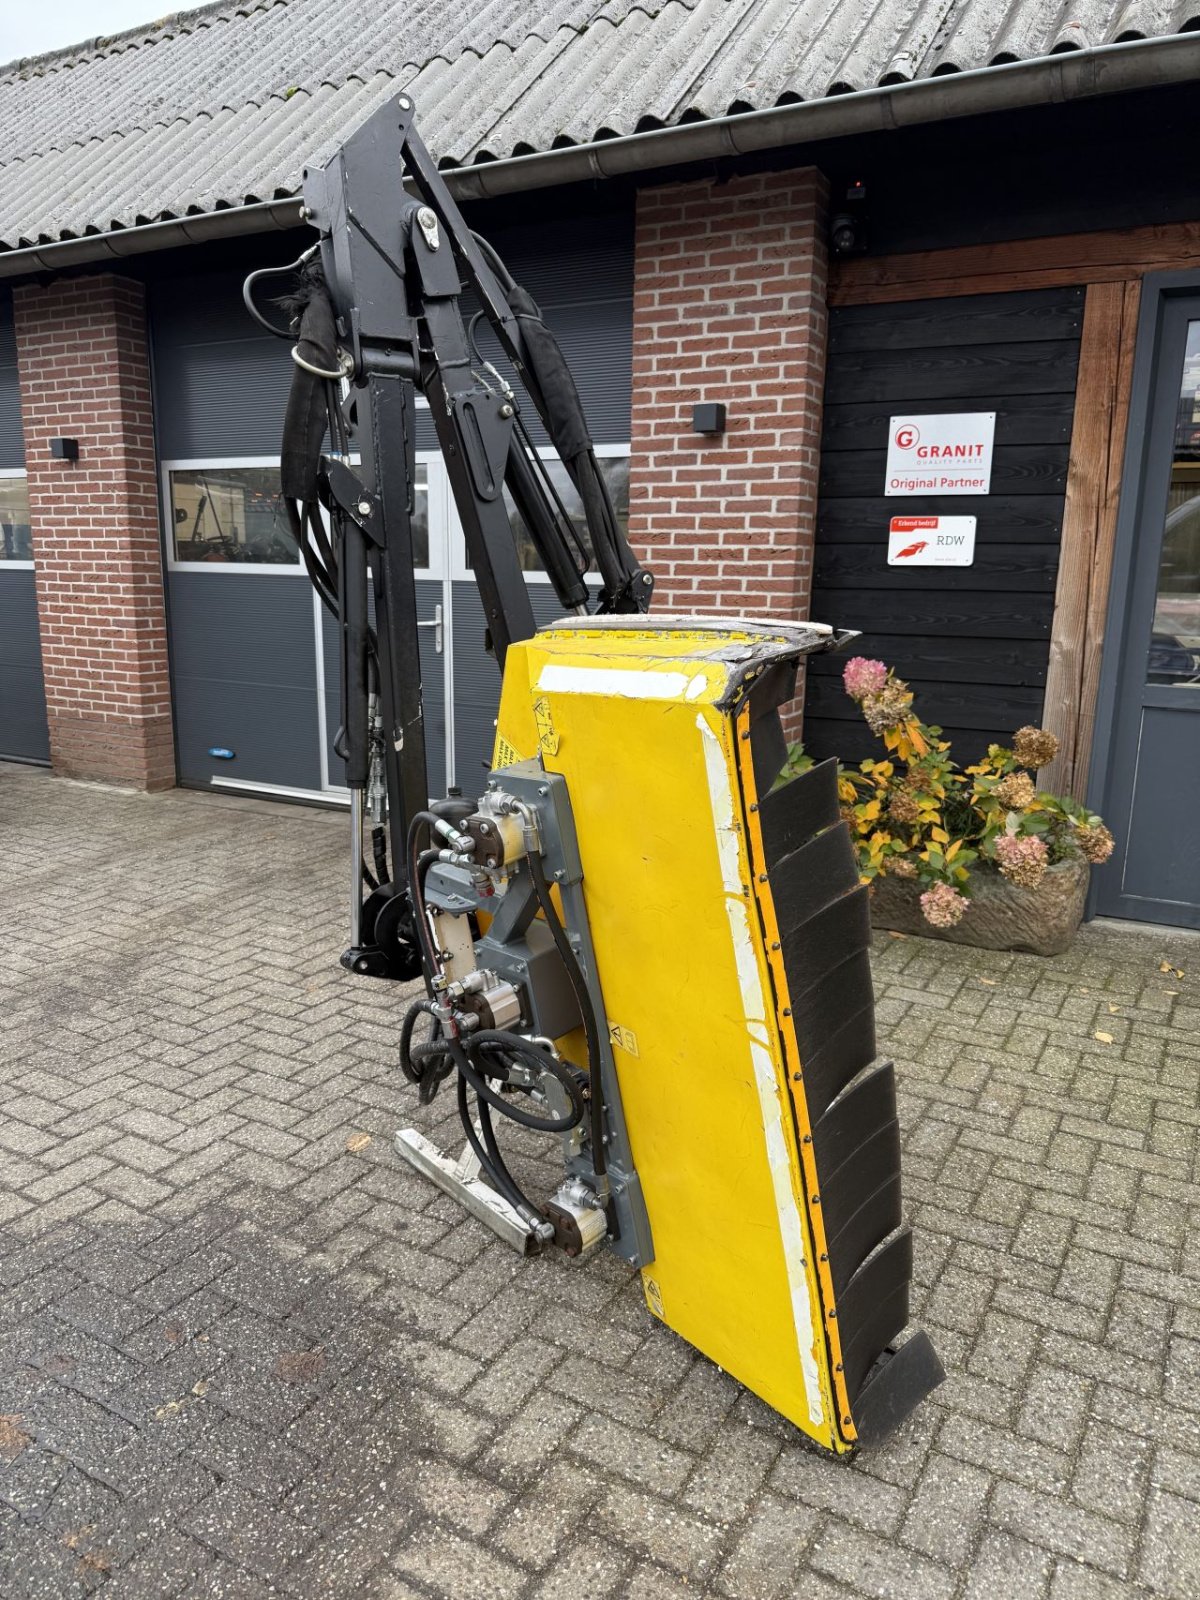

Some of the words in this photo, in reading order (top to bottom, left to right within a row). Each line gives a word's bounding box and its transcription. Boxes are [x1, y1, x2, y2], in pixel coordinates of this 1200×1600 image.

[917, 444, 984, 458] GRANIT
[890, 477, 937, 491] Original
[940, 477, 985, 488] Partner
[936, 535, 965, 546] RDW
